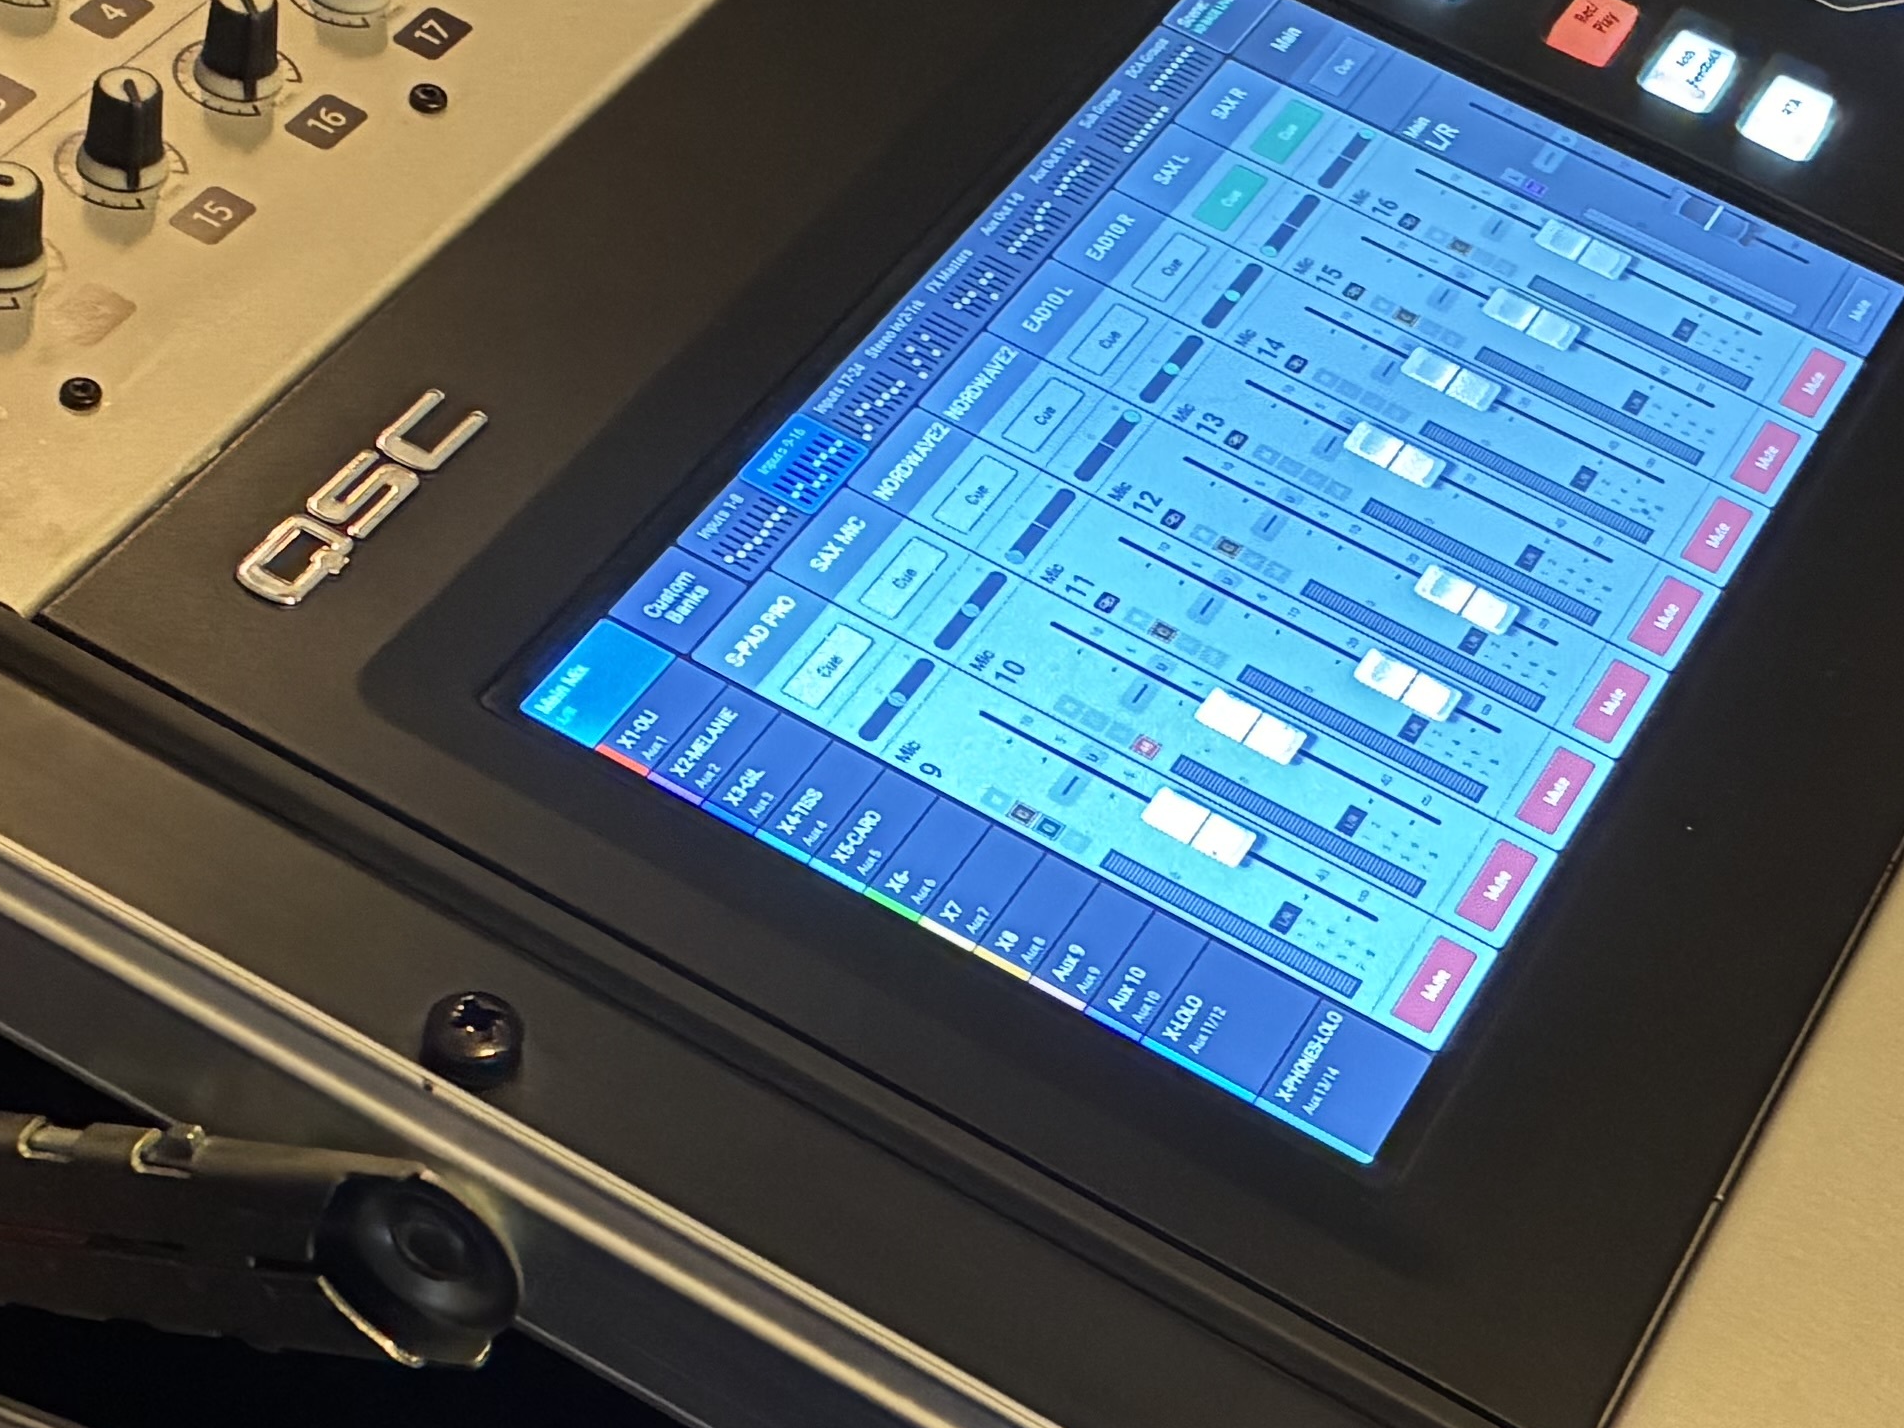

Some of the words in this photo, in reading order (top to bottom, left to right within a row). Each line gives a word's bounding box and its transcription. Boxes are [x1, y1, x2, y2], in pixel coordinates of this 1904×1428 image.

[99, 3, 128, 22] 4
[414, 19, 452, 46] 17
[1270, 25, 1302, 53] Main
[1334, 57, 1356, 76] Cue
[307, 107, 347, 134] 16
[1210, 95, 1241, 121] SAX
[1277, 123, 1299, 142] Cue
[1401, 115, 1432, 141] Main
[1424, 123, 1461, 154] L/R
[1152, 160, 1183, 187] SAX
[1221, 188, 1243, 208] Cue
[1349, 187, 1372, 207] Mic
[1371, 199, 1399, 217] 16
[193, 200, 234, 228] 15
[1085, 225, 1127, 262] EAD10
[937, 248, 974, 284] Masters
[1161, 257, 1184, 277] Cue
[1293, 255, 1315, 276] Mic
[1315, 266, 1344, 286] 15
[1022, 296, 1064, 333] EAD10
[1848, 297, 1874, 324] Mute
[1099, 328, 1123, 350] Cue
[1233, 327, 1258, 348] Mic
[1256, 337, 1286, 359] 14
[812, 383, 843, 415] Inputs
[838, 363, 866, 392] 17-24
[943, 345, 1020, 421] NORDWAVE2
[1801, 370, 1827, 396] Mute
[1034, 405, 1057, 426] Cue
[1171, 402, 1197, 424] Mic
[1195, 412, 1226, 433] 13
[756, 447, 787, 476] Inputs
[872, 421, 951, 502] NORDWAVE2
[1755, 443, 1781, 472] Mute
[236, 388, 489, 606] QSC
[963, 483, 991, 507] Cue
[1107, 481, 1133, 503] Mic
[1132, 489, 1164, 513] 12
[696, 505, 731, 540] Inputs
[1705, 522, 1731, 549] Mute
[809, 539, 844, 573] SAX
[838, 515, 867, 549] MIC
[892, 567, 918, 590] Cue
[1039, 562, 1066, 585] Mic
[1065, 573, 1096, 597] 11
[643, 571, 697, 620] Custom
[664, 584, 710, 625] Banks
[1653, 601, 1680, 630] Mute
[724, 623, 770, 668] S-PAD
[761, 595, 798, 635] PRO
[815, 651, 844, 680] Cue
[969, 649, 996, 671] Mic
[995, 659, 1026, 684] 10
[534, 685, 571, 715] Main
[1598, 687, 1627, 717] Mute
[670, 706, 739, 778] X2-MELANIE
[894, 739, 922, 764] Mic
[919, 762, 943, 778] 9
[1542, 776, 1571, 807] Mute
[830, 810, 882, 865] X5-CARO
[1482, 870, 1512, 902] Mute
[939, 900, 964, 923] X7
[995, 930, 1020, 954] X8
[1051, 955, 1079, 983] Aux
[1107, 986, 1134, 1013] Aux
[1127, 966, 1147, 990] 10
[1420, 968, 1452, 1003] Mute
[1161, 995, 1204, 1042] X-LOLO
[1188, 1034, 1207, 1055] Aux
[1202, 1005, 1227, 1039] 11/12
[1274, 1010, 1344, 1104] X-PHONES-LOLO
[1302, 1094, 1321, 1117] Aux
[1315, 1066, 1340, 1099] 13/14
